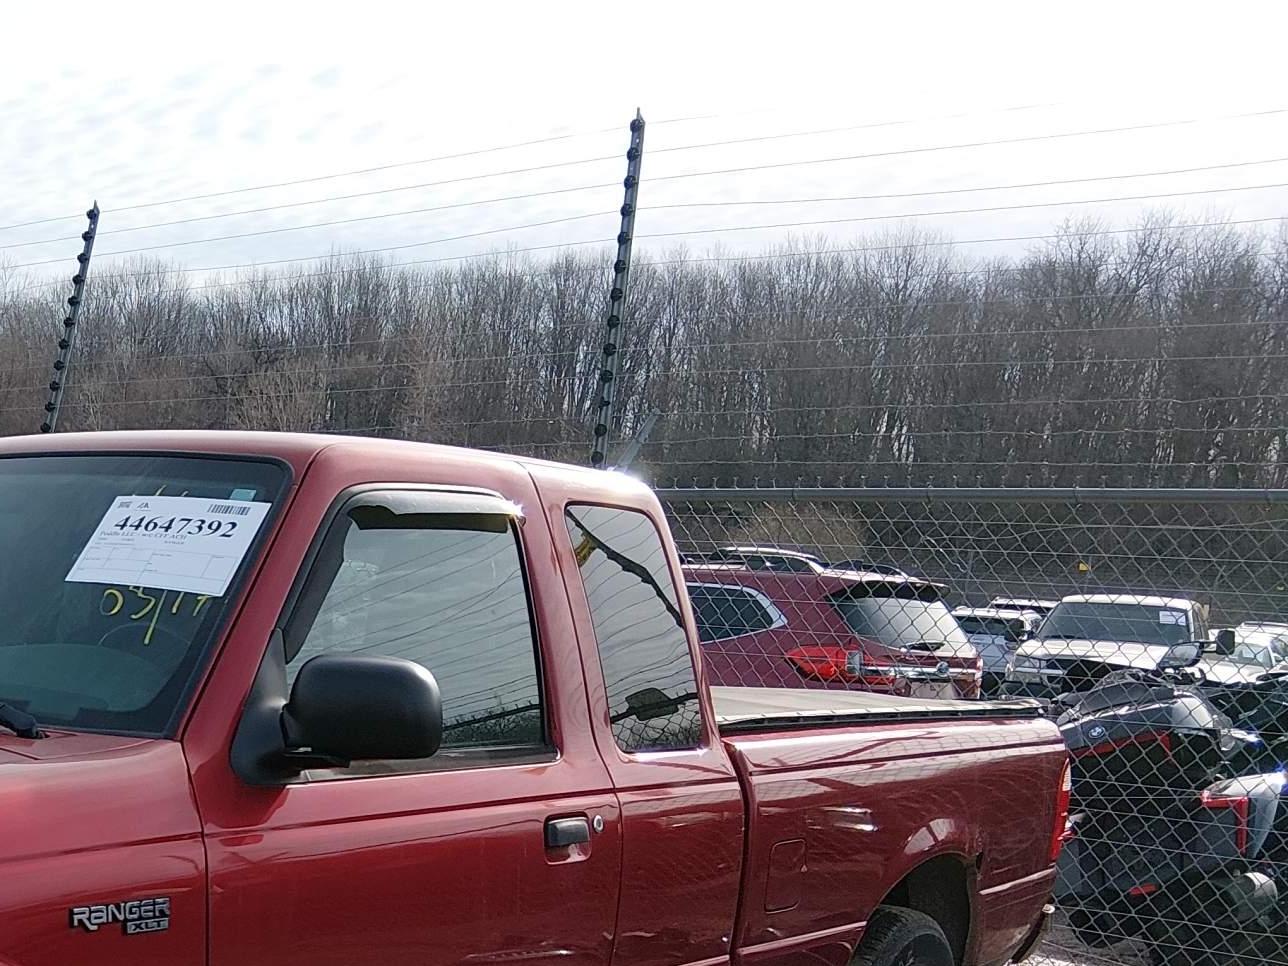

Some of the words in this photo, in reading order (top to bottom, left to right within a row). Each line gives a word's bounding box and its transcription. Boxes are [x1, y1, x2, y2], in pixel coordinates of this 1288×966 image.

[114, 515, 238, 538] 44647392
[72, 897, 171, 931] RANGER
[129, 919, 167, 933] XLT
